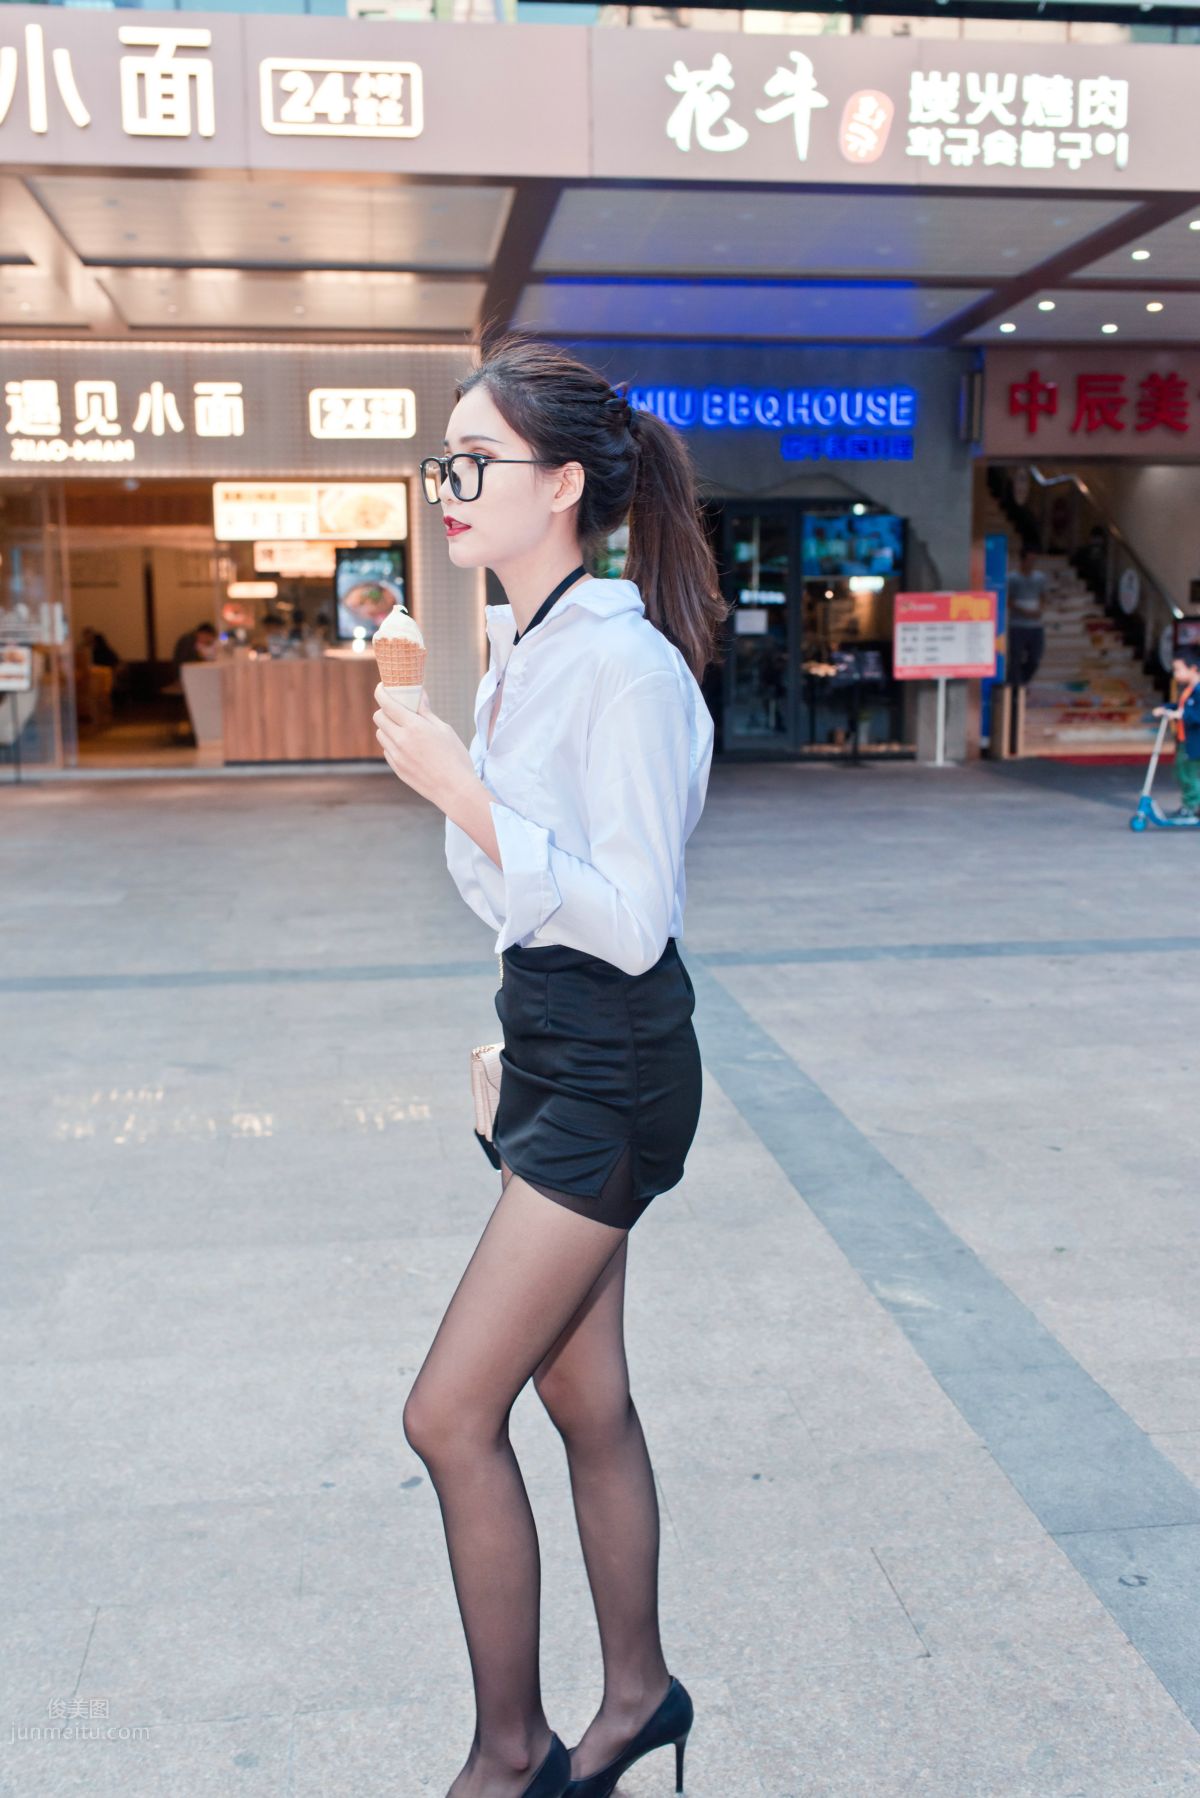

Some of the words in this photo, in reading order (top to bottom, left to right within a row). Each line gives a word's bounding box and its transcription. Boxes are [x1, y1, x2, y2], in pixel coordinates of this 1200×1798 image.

[0, 23, 215, 137] 小面
[280, 70, 351, 124] 24
[665, 50, 829, 161] 花牛
[908, 70, 1129, 129] 炭火烤肉
[5, 379, 245, 437] 遇见小面
[1007, 370, 1190, 434] 中辰美
